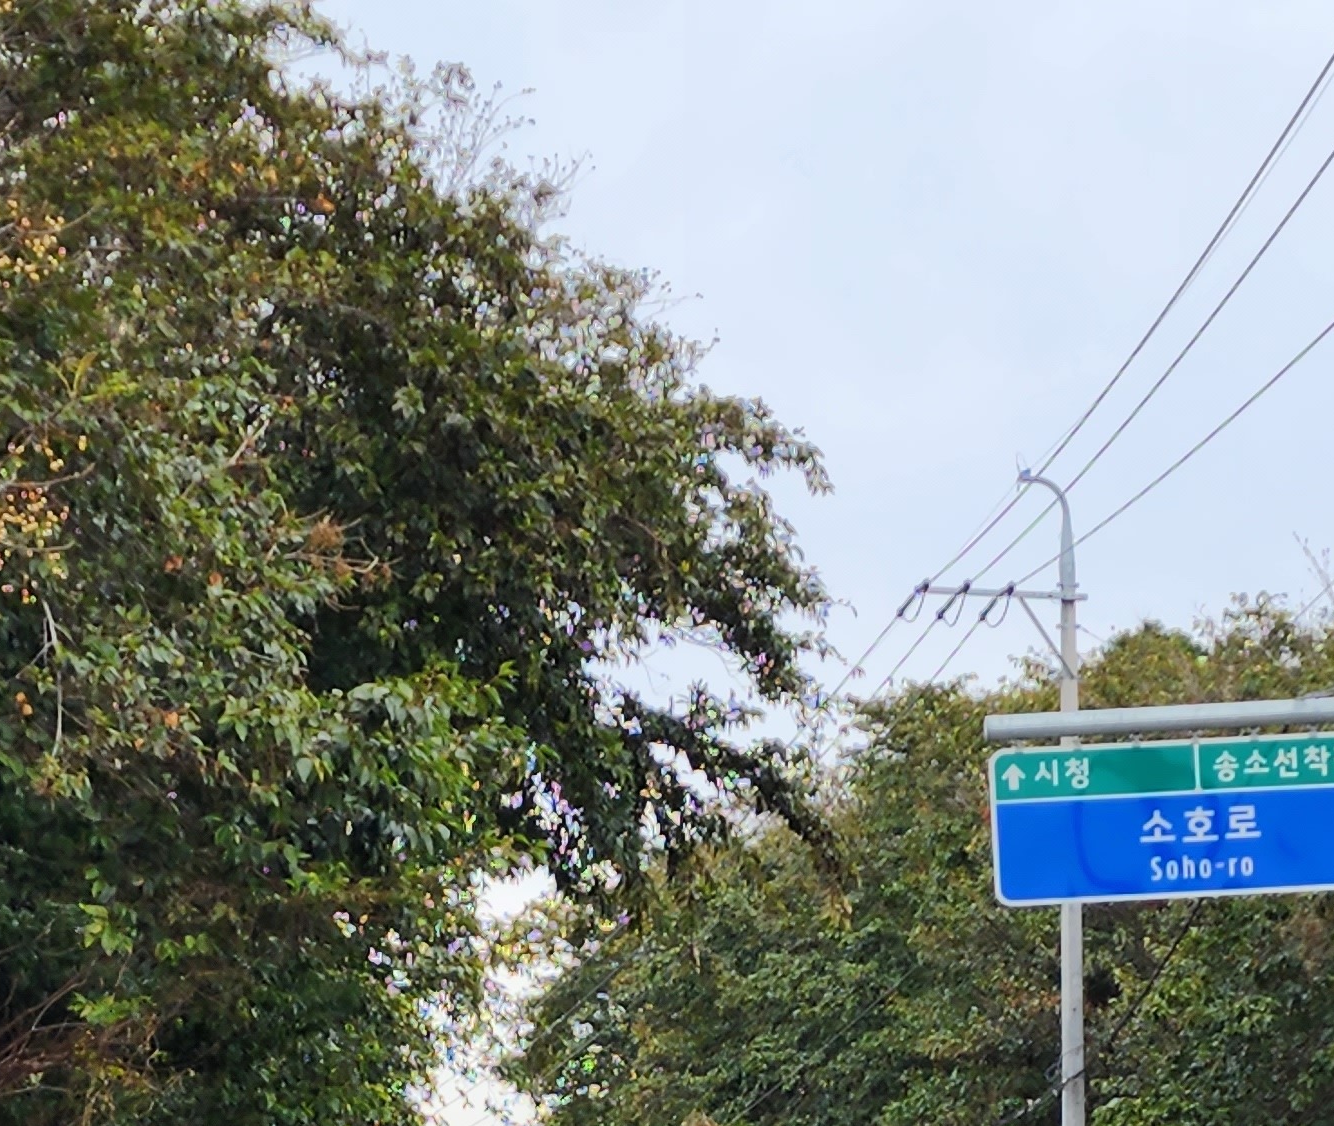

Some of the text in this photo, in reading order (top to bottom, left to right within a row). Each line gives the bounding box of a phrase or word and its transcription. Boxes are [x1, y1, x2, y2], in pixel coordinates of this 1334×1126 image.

[1034, 757, 1090, 789] 시청
[1139, 805, 1262, 844] 소호로
[1150, 855, 1254, 881] Soho-ro
